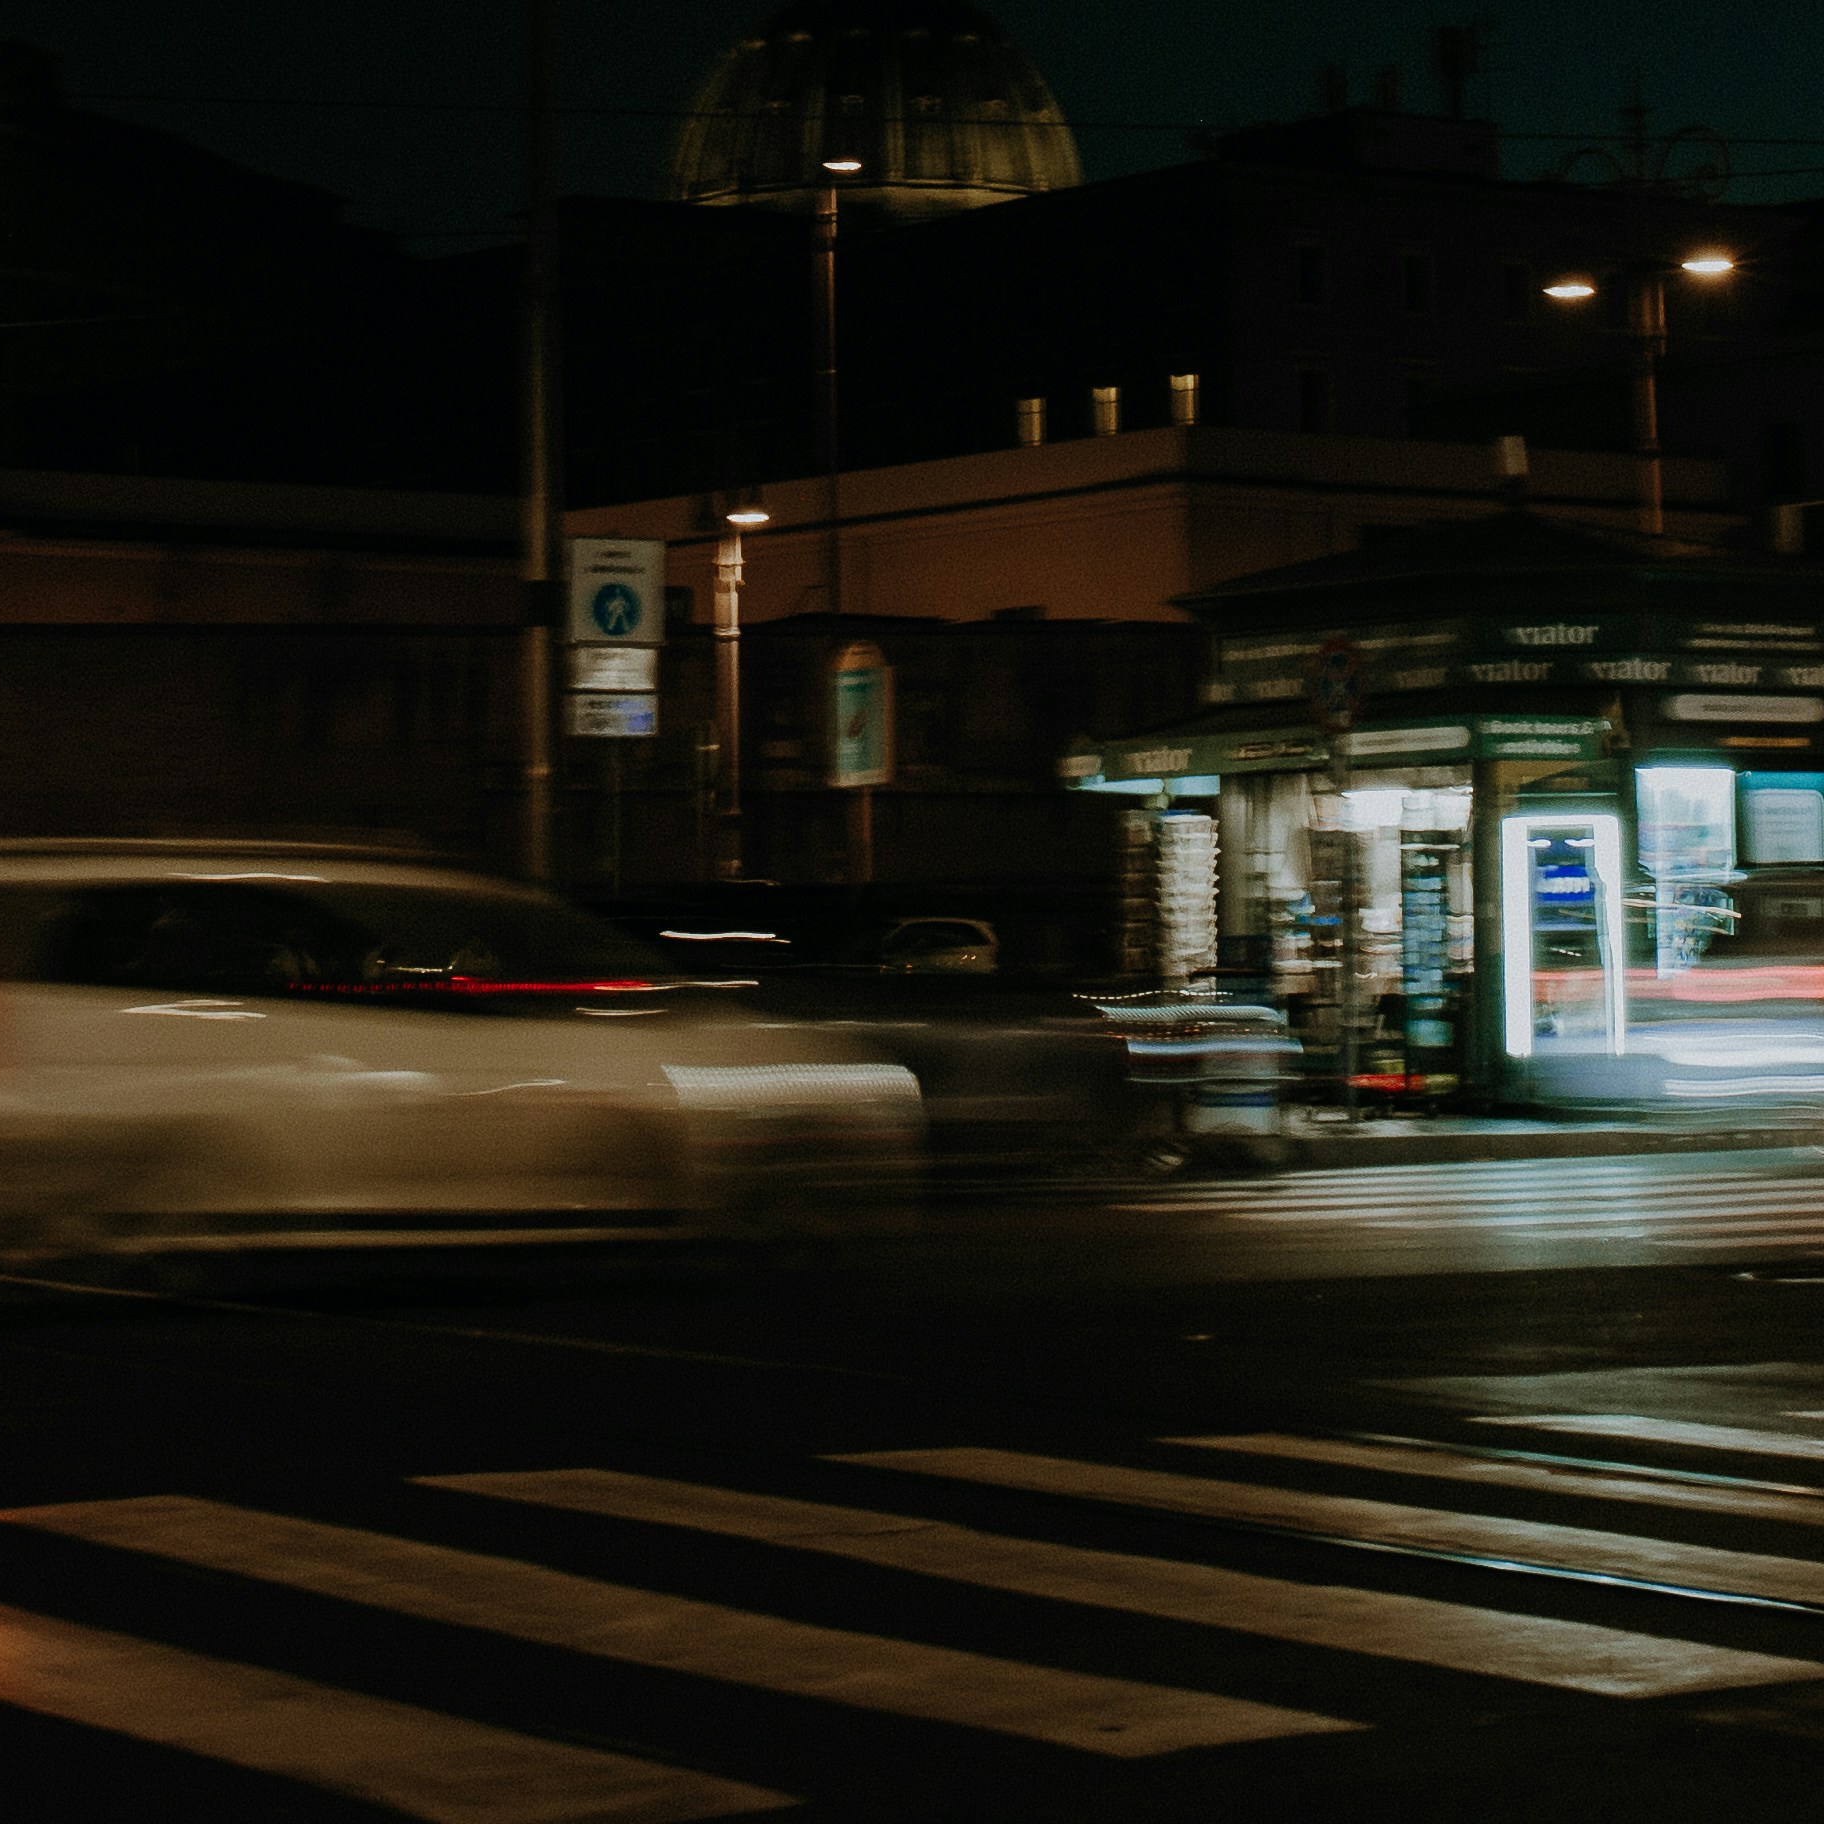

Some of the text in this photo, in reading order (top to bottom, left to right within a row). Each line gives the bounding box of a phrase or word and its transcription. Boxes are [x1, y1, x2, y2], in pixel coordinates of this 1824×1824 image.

[1510, 623, 1599, 646] viator
[1468, 659, 1553, 682] viator
[1587, 658, 1672, 681] viator
